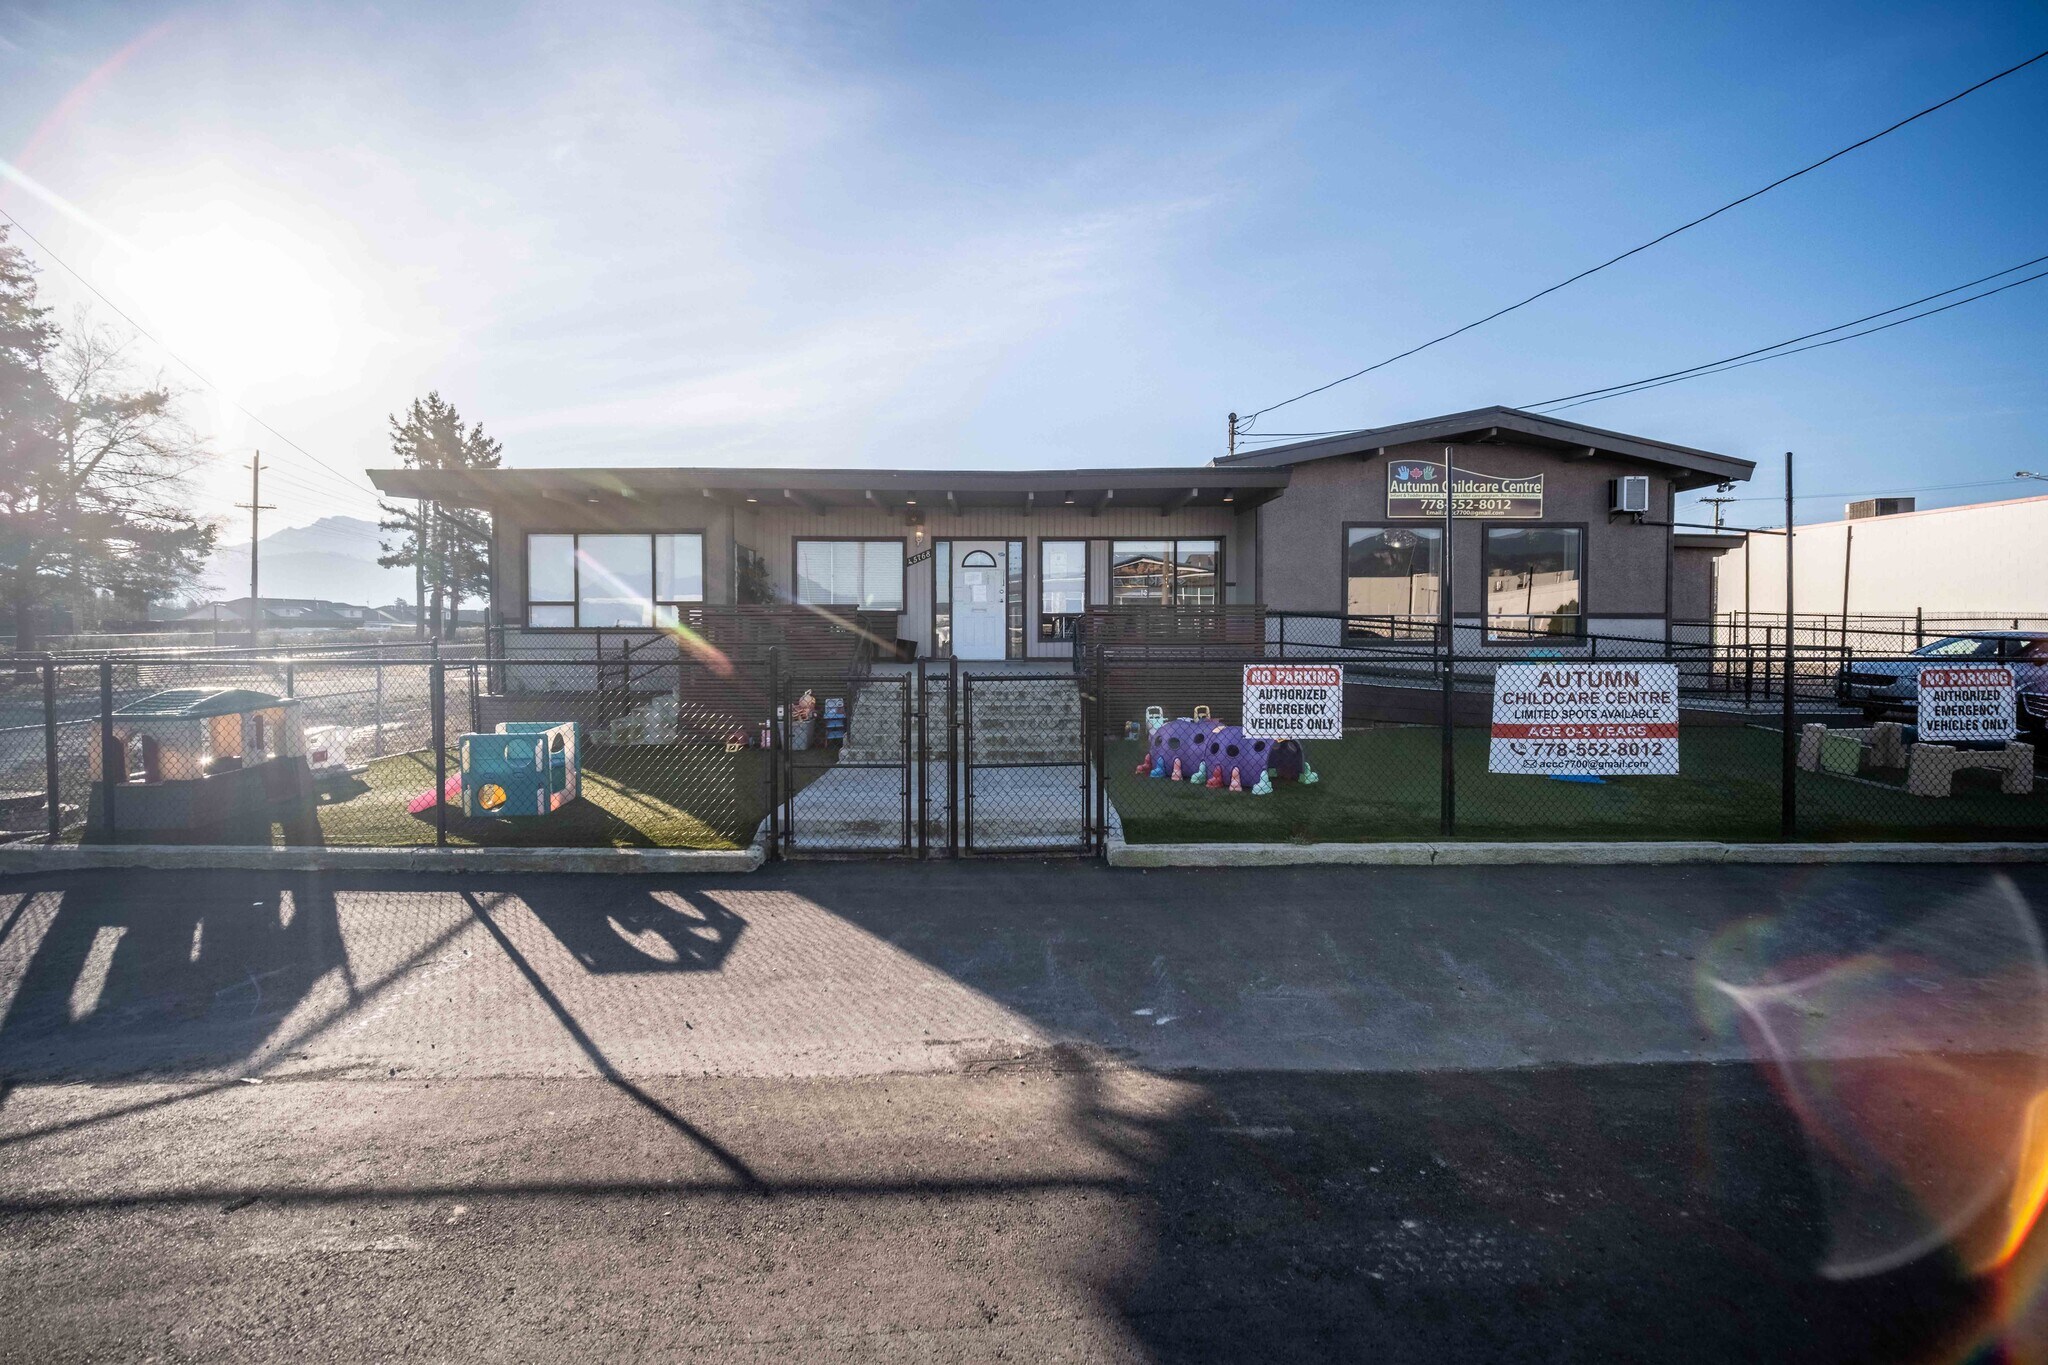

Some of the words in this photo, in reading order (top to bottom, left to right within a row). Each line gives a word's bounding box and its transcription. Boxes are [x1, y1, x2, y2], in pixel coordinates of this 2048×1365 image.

[1390, 480, 1439, 493] Autumn
[1501, 480, 1541, 493] Centre
[1420, 499, 1512, 510] 778-552-8012
[1251, 670, 1272, 684] NO
[1275, 670, 1336, 684] PARKING
[1537, 671, 1640, 688] AUTUMN
[1925, 672, 1945, 686] NO
[1949, 671, 2009, 686] PARKING
[1258, 688, 1327, 700] AUTHORIZED
[1502, 691, 1601, 705] CHILDCARE
[1605, 691, 1671, 704] CENTRE
[1933, 690, 2001, 701] AUTHORIZED
[1259, 703, 1326, 715] EMERGENCY
[1514, 709, 1559, 719] LIMITED
[1561, 709, 1597, 719] SPOTS
[1600, 709, 1660, 719] AVAILABLE
[1934, 704, 2000, 716] EMERGENCY
[1250, 718, 1304, 730] VEHICLES
[1306, 718, 1334, 730] ONLY
[1926, 719, 1979, 731] VEHICLES
[1982, 719, 2009, 731] ONLY
[1528, 726, 1561, 737] AGE
[1596, 726, 1647, 736] YEARS
[1532, 742, 1663, 757] 778-552-8012
[1539, 760, 1649, 769] accc7700@gmail.com
